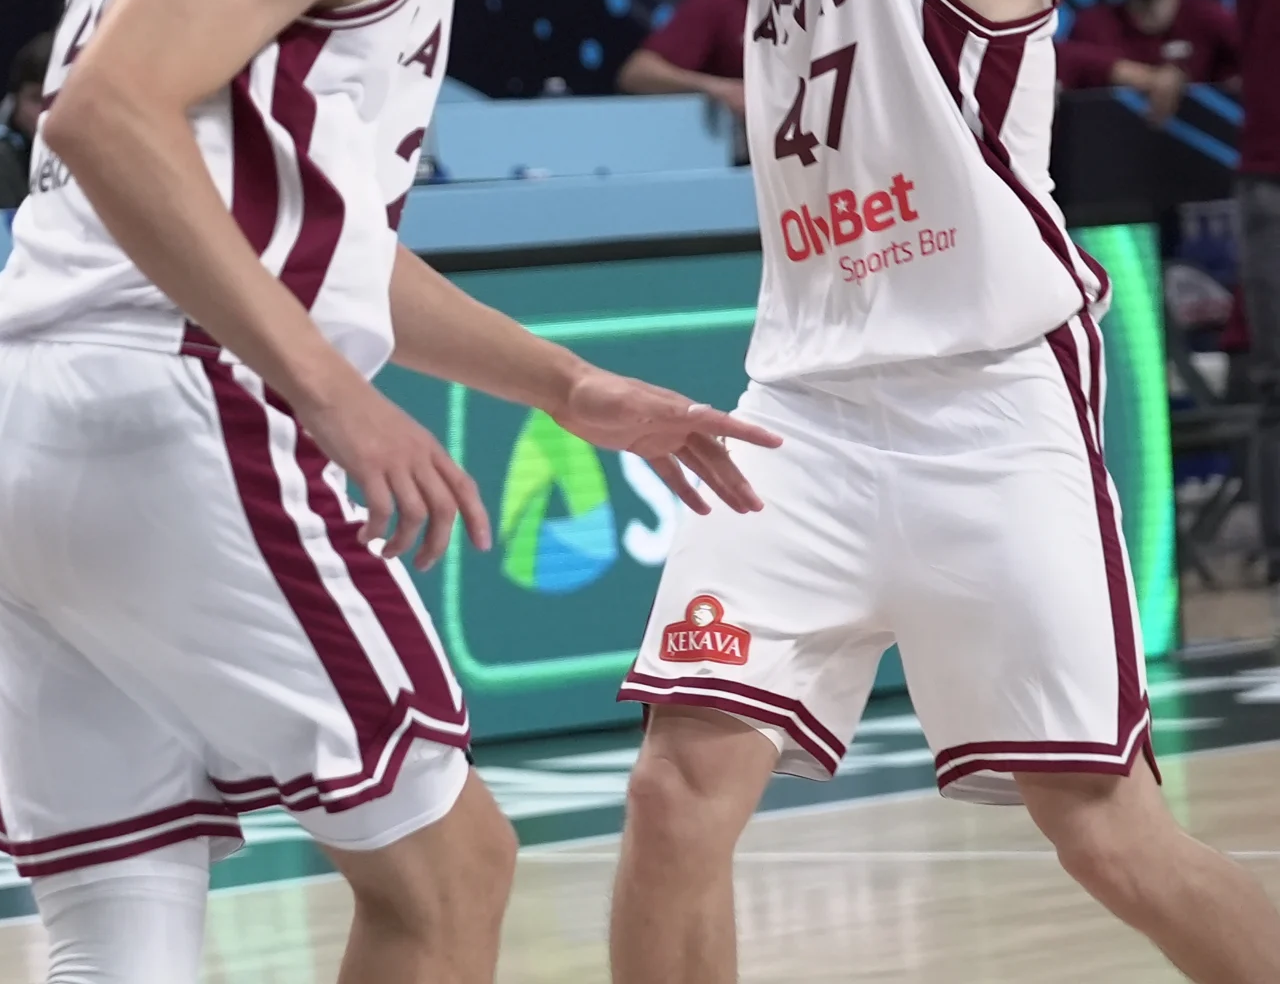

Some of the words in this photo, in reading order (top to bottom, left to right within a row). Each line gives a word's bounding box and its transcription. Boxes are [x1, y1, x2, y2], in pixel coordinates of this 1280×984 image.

[774, 42, 858, 167] 47
[838, 240, 914, 285] Sports
[918, 227, 957, 256] Bar
